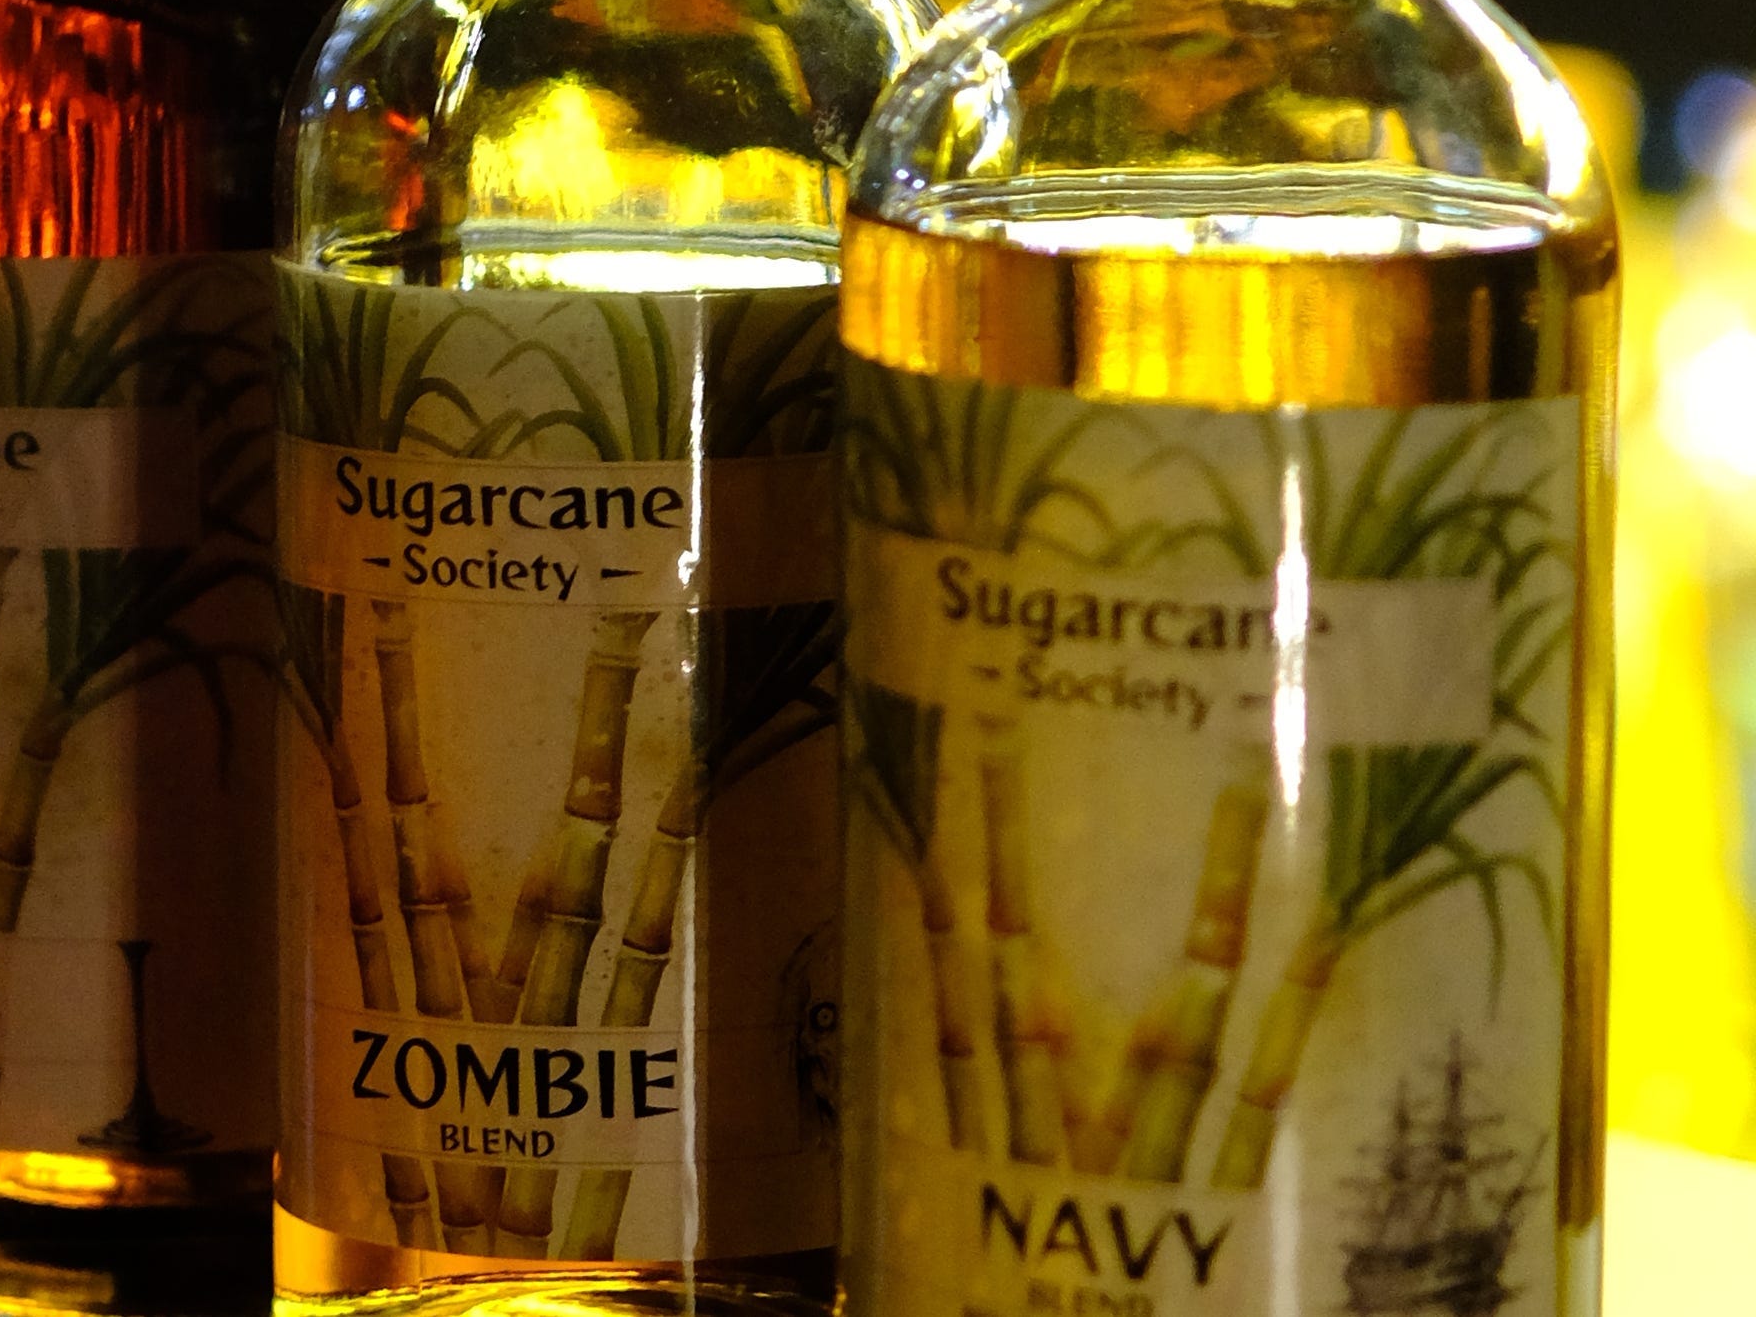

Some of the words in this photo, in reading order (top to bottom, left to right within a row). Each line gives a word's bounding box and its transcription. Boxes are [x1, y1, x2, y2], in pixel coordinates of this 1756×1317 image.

[336, 456, 684, 536] Sugarcane
[404, 543, 578, 601] Society
[938, 555, 1331, 648] Sugarcan
[1015, 651, 1211, 731] Society
[353, 1029, 679, 1119] ZOMBIE
[439, 1123, 555, 1158] BLEND
[979, 1182, 1234, 1288] NAVY
